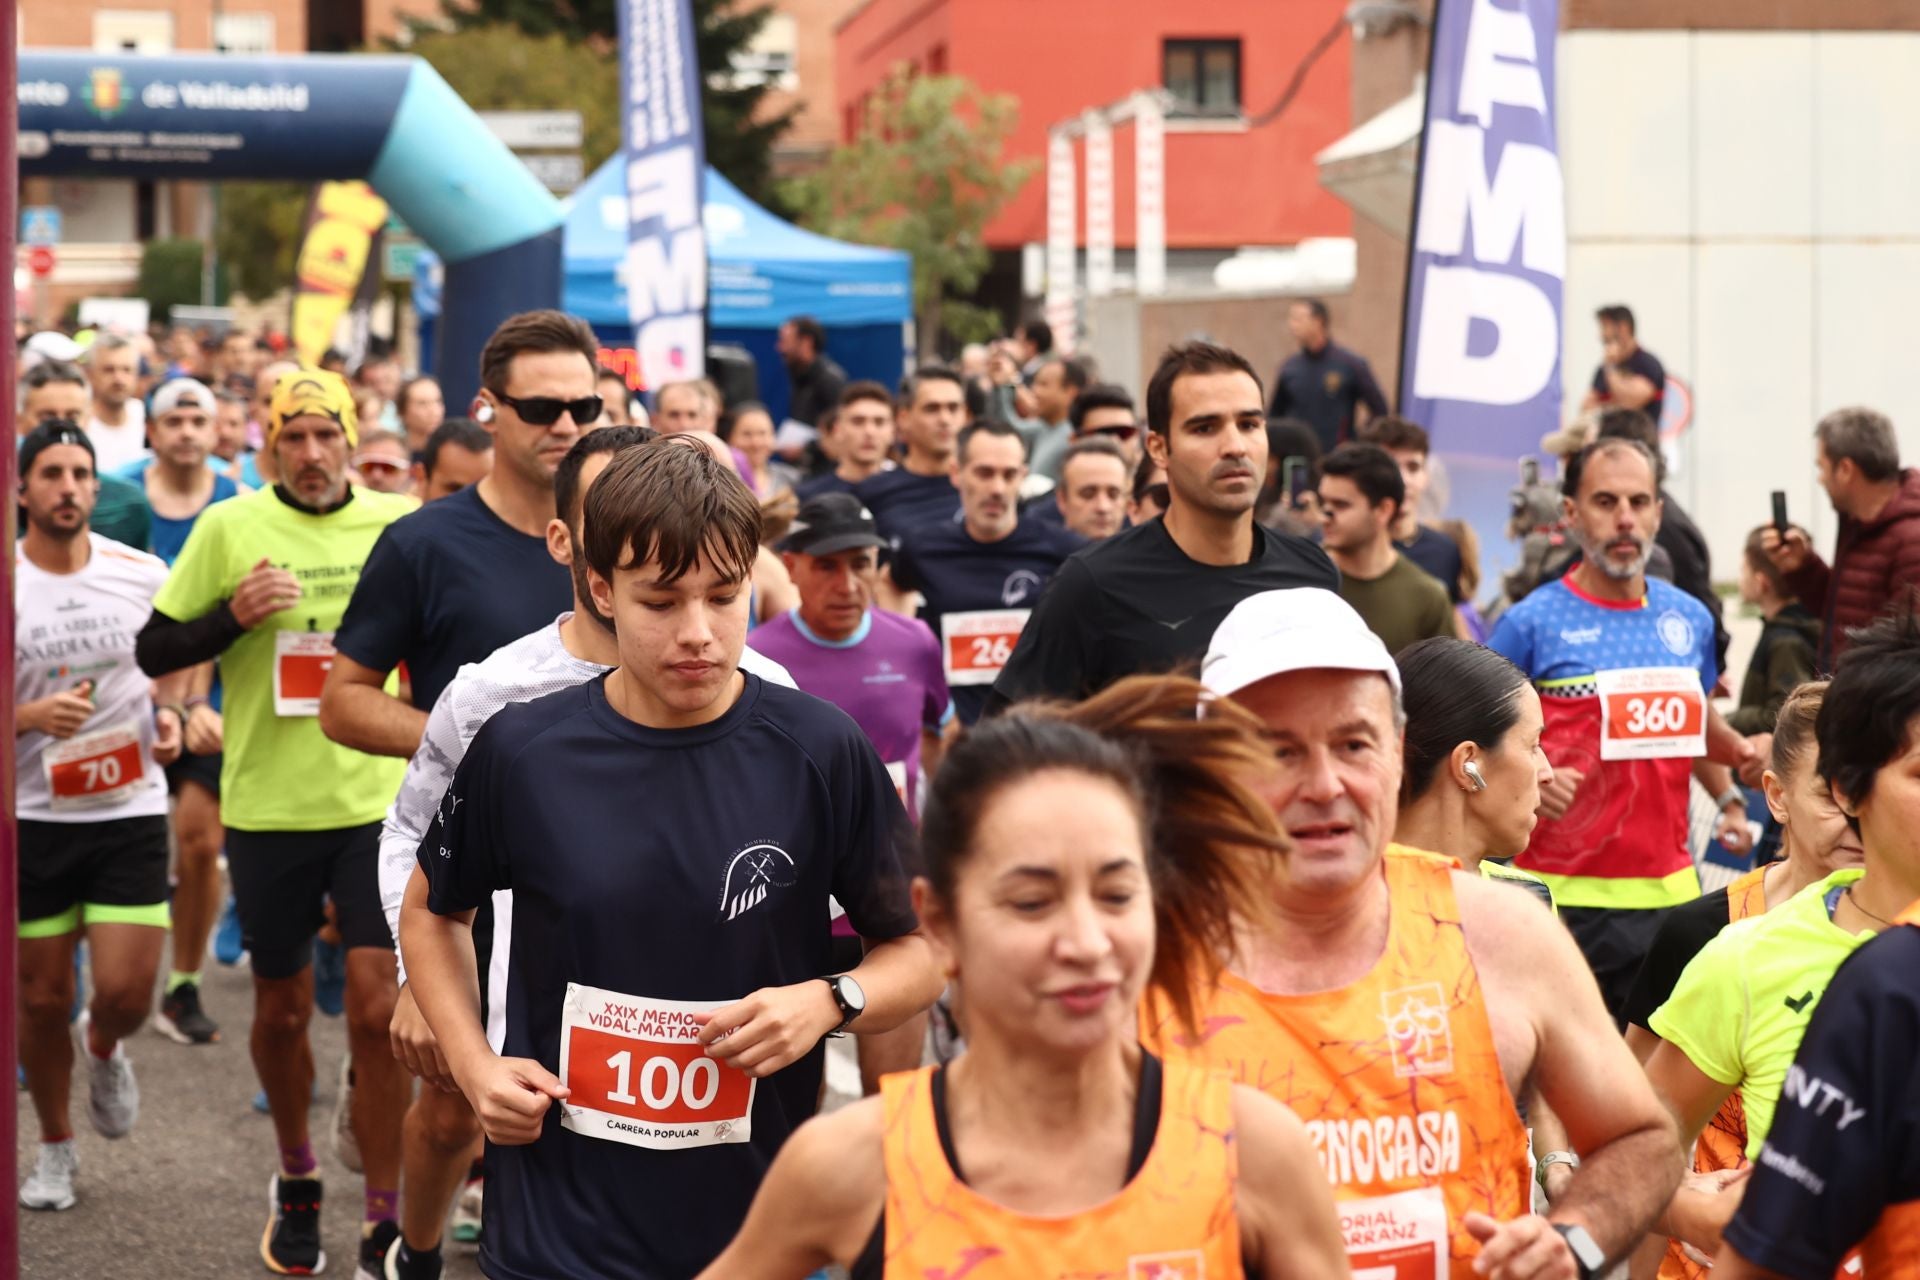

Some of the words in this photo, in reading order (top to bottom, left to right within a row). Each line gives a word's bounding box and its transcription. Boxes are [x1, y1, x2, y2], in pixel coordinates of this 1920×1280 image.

[142, 80, 178, 109] de
[178, 80, 310, 112] Valladolid
[1626, 696, 1688, 734] 360
[78, 755, 121, 791] 70
[604, 1002, 638, 1020] XXIX
[643, 1009, 695, 1027] MEMO
[606, 1050, 720, 1110] 100
[607, 1119, 651, 1137] CARRERA
[654, 1128, 699, 1139] POPULAR
